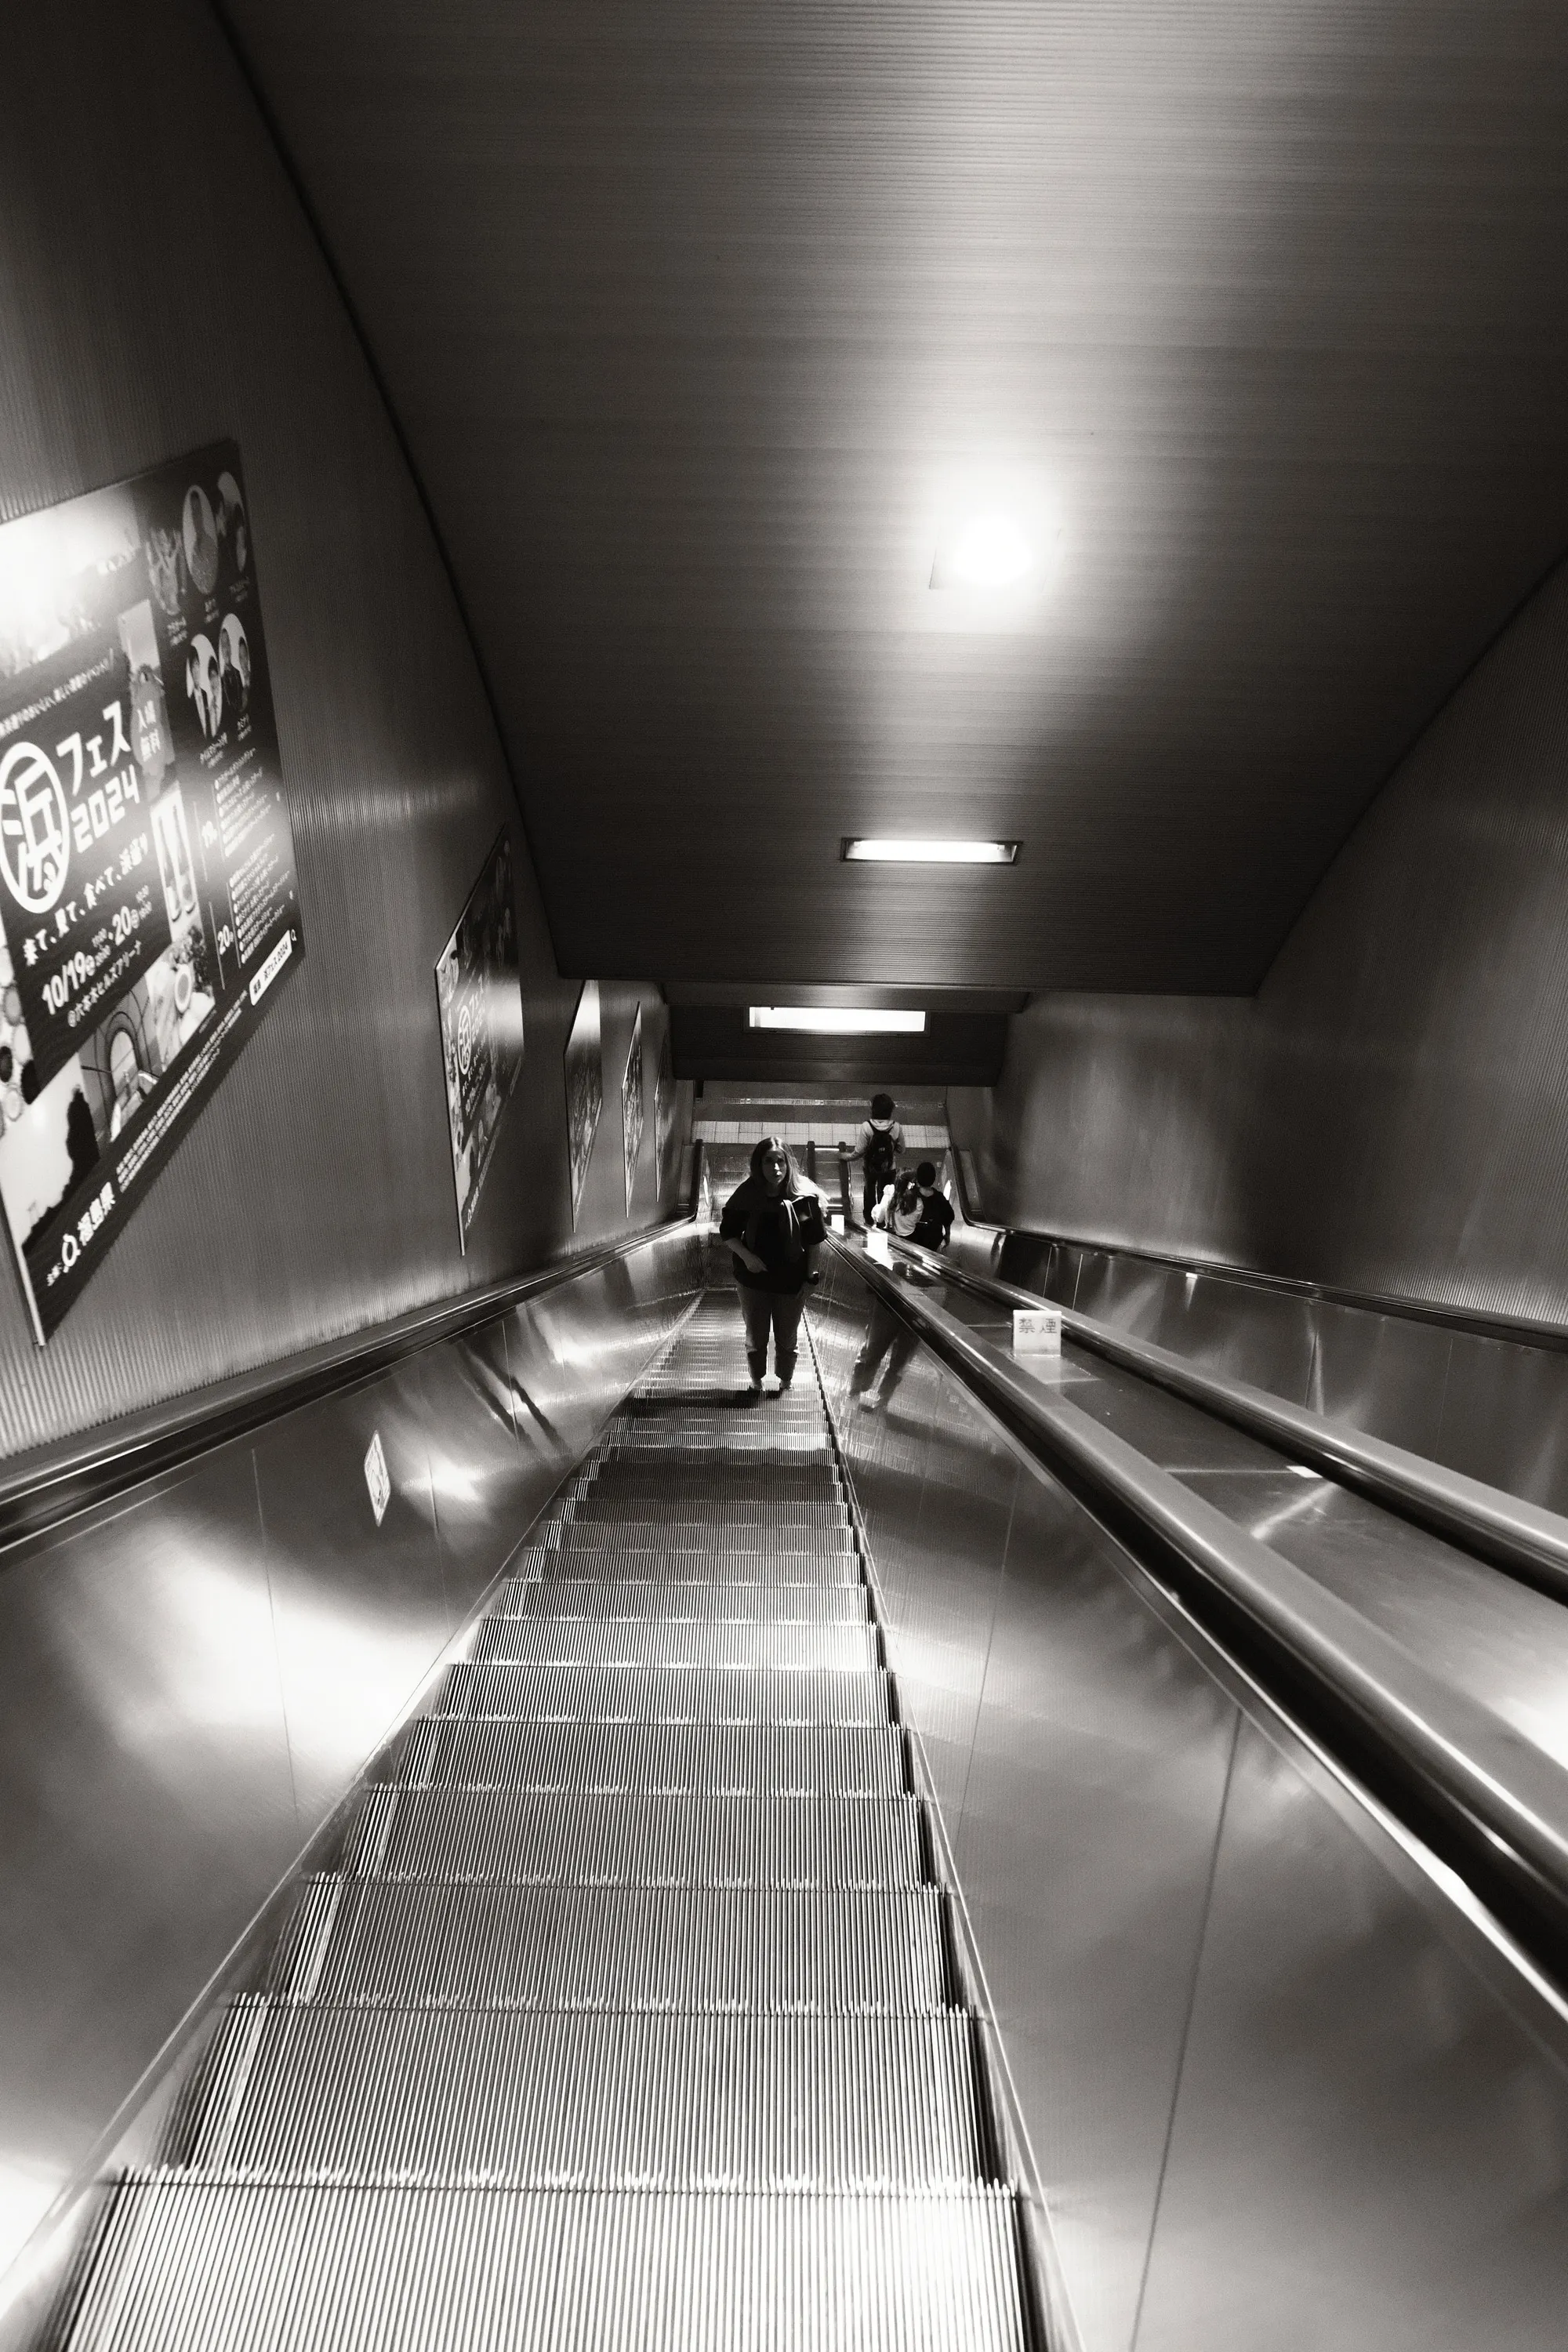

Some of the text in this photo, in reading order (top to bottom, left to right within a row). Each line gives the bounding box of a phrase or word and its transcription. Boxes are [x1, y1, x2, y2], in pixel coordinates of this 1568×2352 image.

[56, 700, 132, 797] フェス
[70, 764, 140, 854] 2024
[1018, 1318, 1058, 1334] 禁煙
